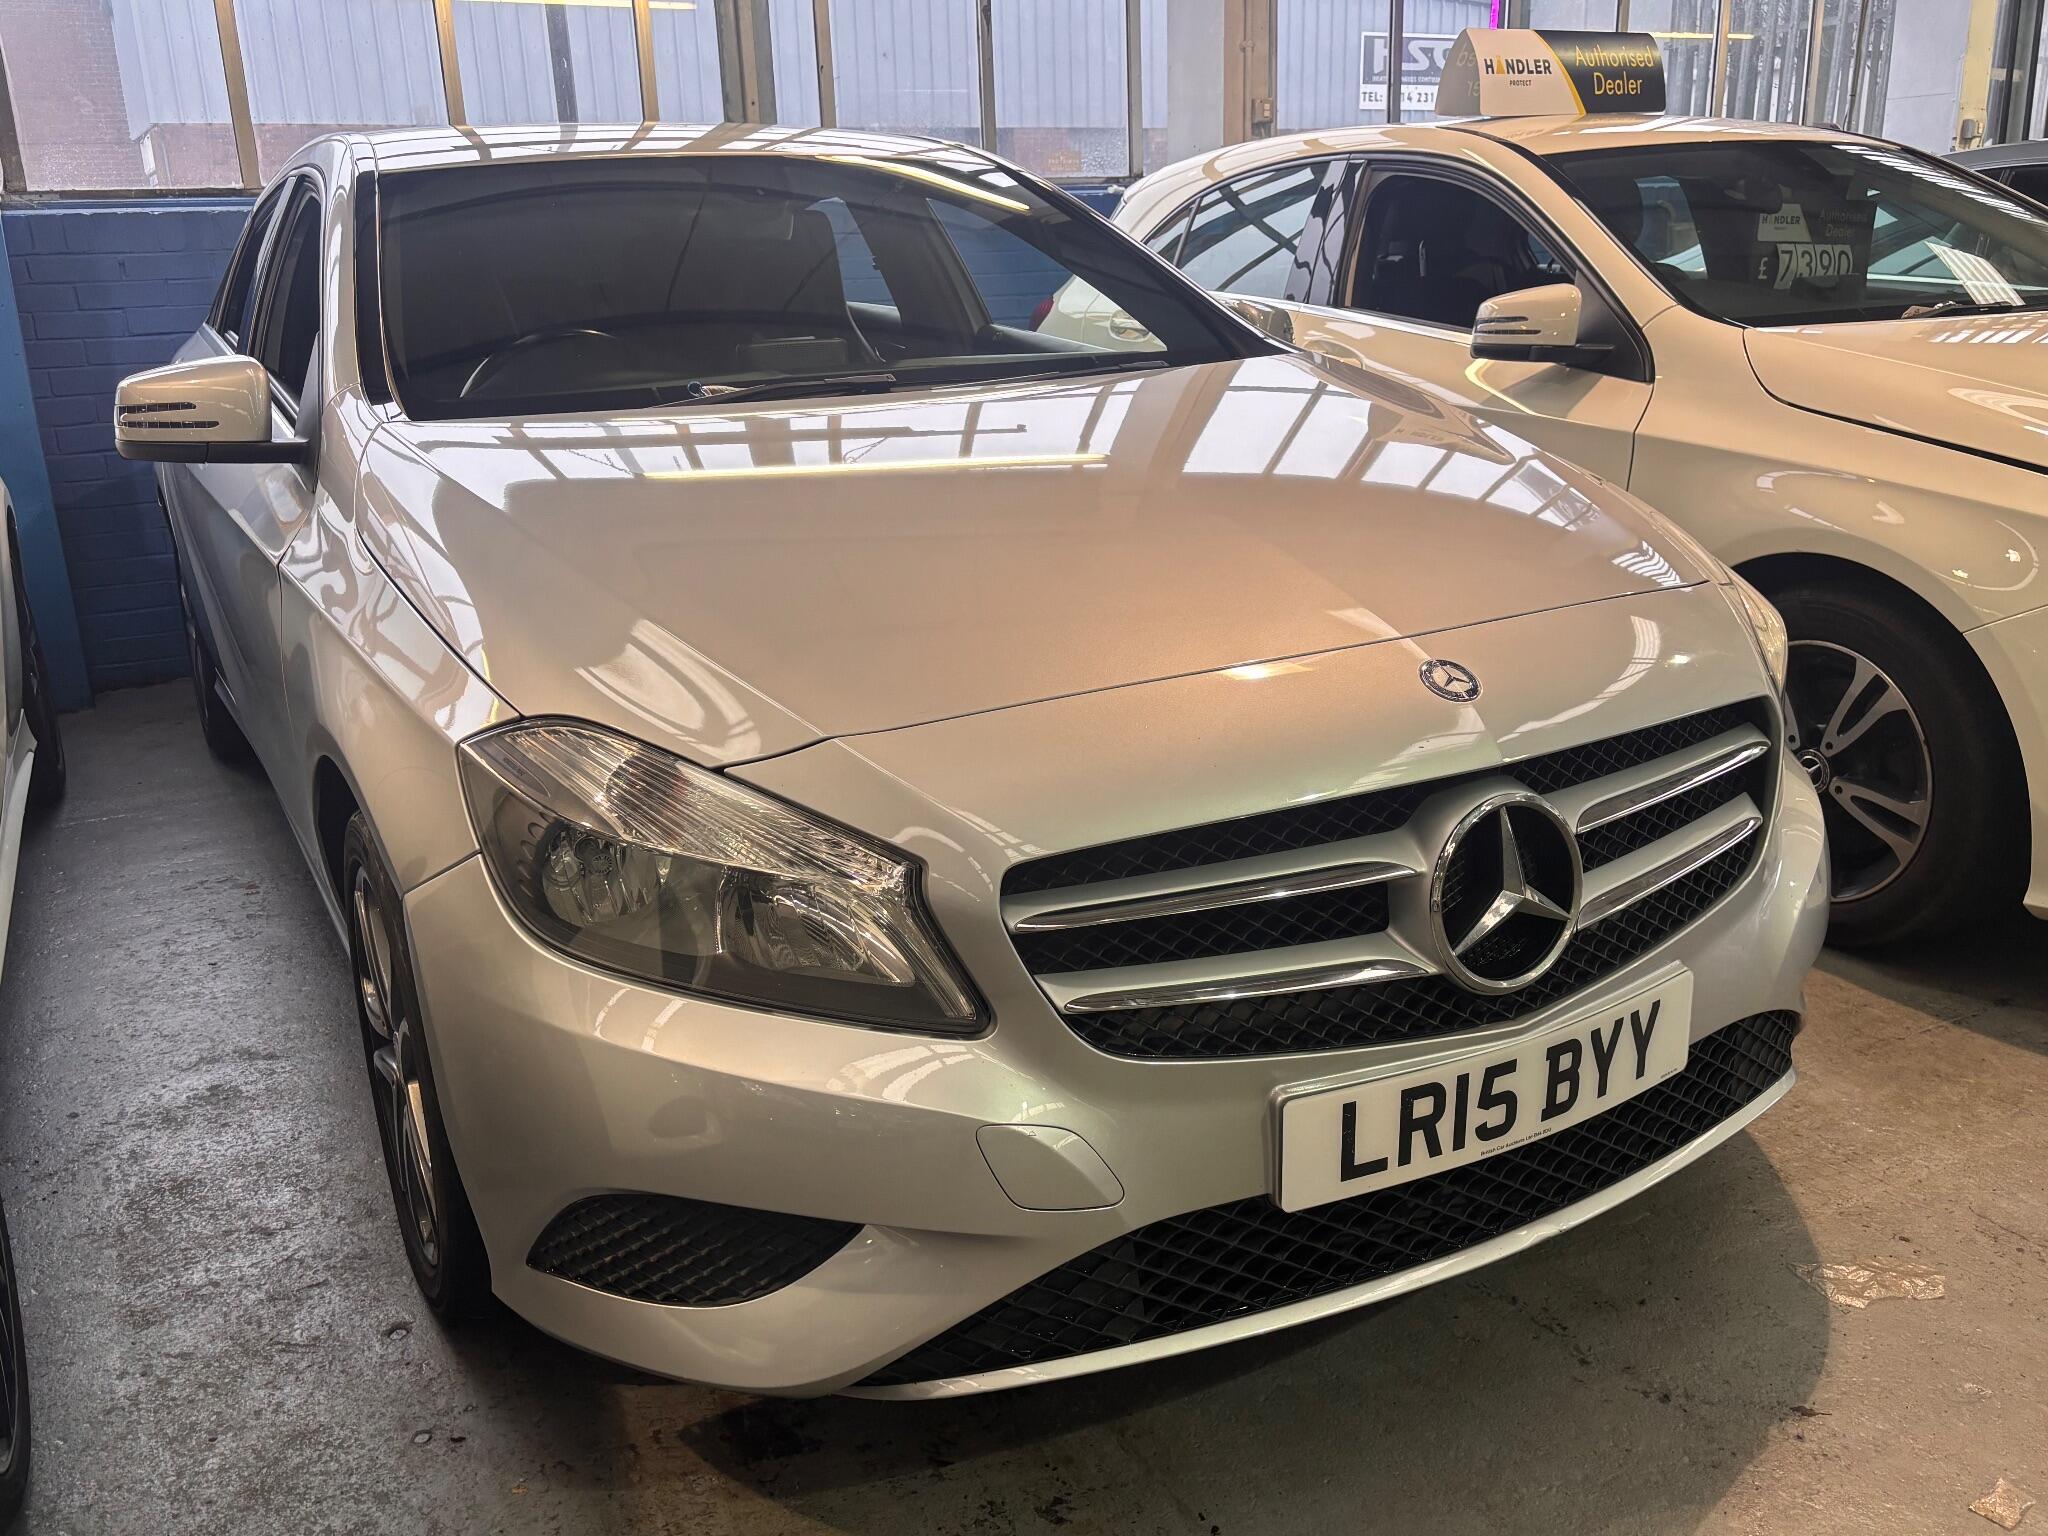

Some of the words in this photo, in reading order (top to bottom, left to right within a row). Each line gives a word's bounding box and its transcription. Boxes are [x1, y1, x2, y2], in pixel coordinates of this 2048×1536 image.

[1483, 55, 1553, 75] HANDLER
[1575, 44, 1654, 69] Authorised
[1509, 79, 1532, 87] PROTECT
[1594, 71, 1643, 96] Dealer
[1362, 91, 1383, 103] TEL:
[1340, 1058, 1519, 1182] LR15
[1540, 999, 1661, 1122] BYY
